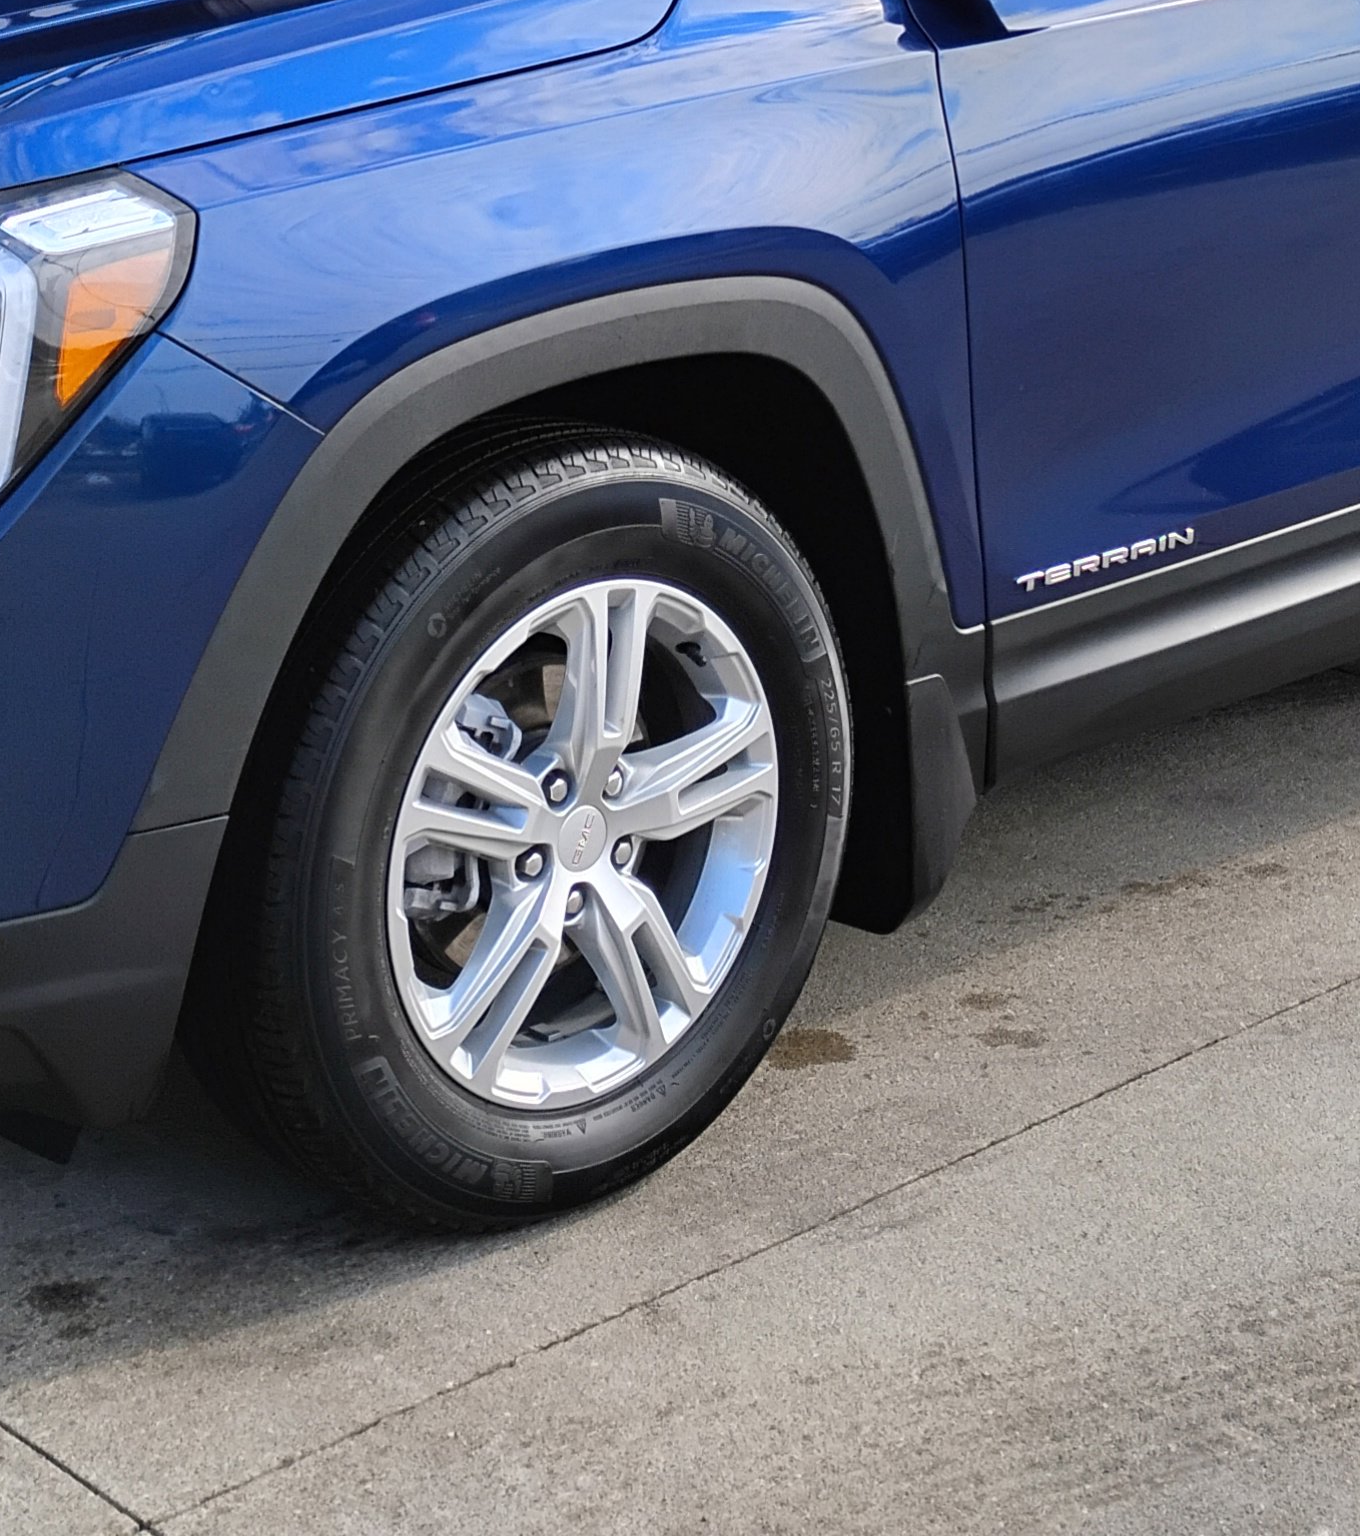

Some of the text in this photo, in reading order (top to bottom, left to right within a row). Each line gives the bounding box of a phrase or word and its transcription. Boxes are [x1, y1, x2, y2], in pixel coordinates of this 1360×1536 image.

[717, 527, 822, 652] MICHELIN
[1015, 527, 1195, 592] TERRAIN
[820, 678, 842, 806] 225/65 R 17
[571, 813, 596, 865] GMC
[332, 928, 363, 1041] PRIMACY
[360, 1064, 489, 1185] MICHELIN
